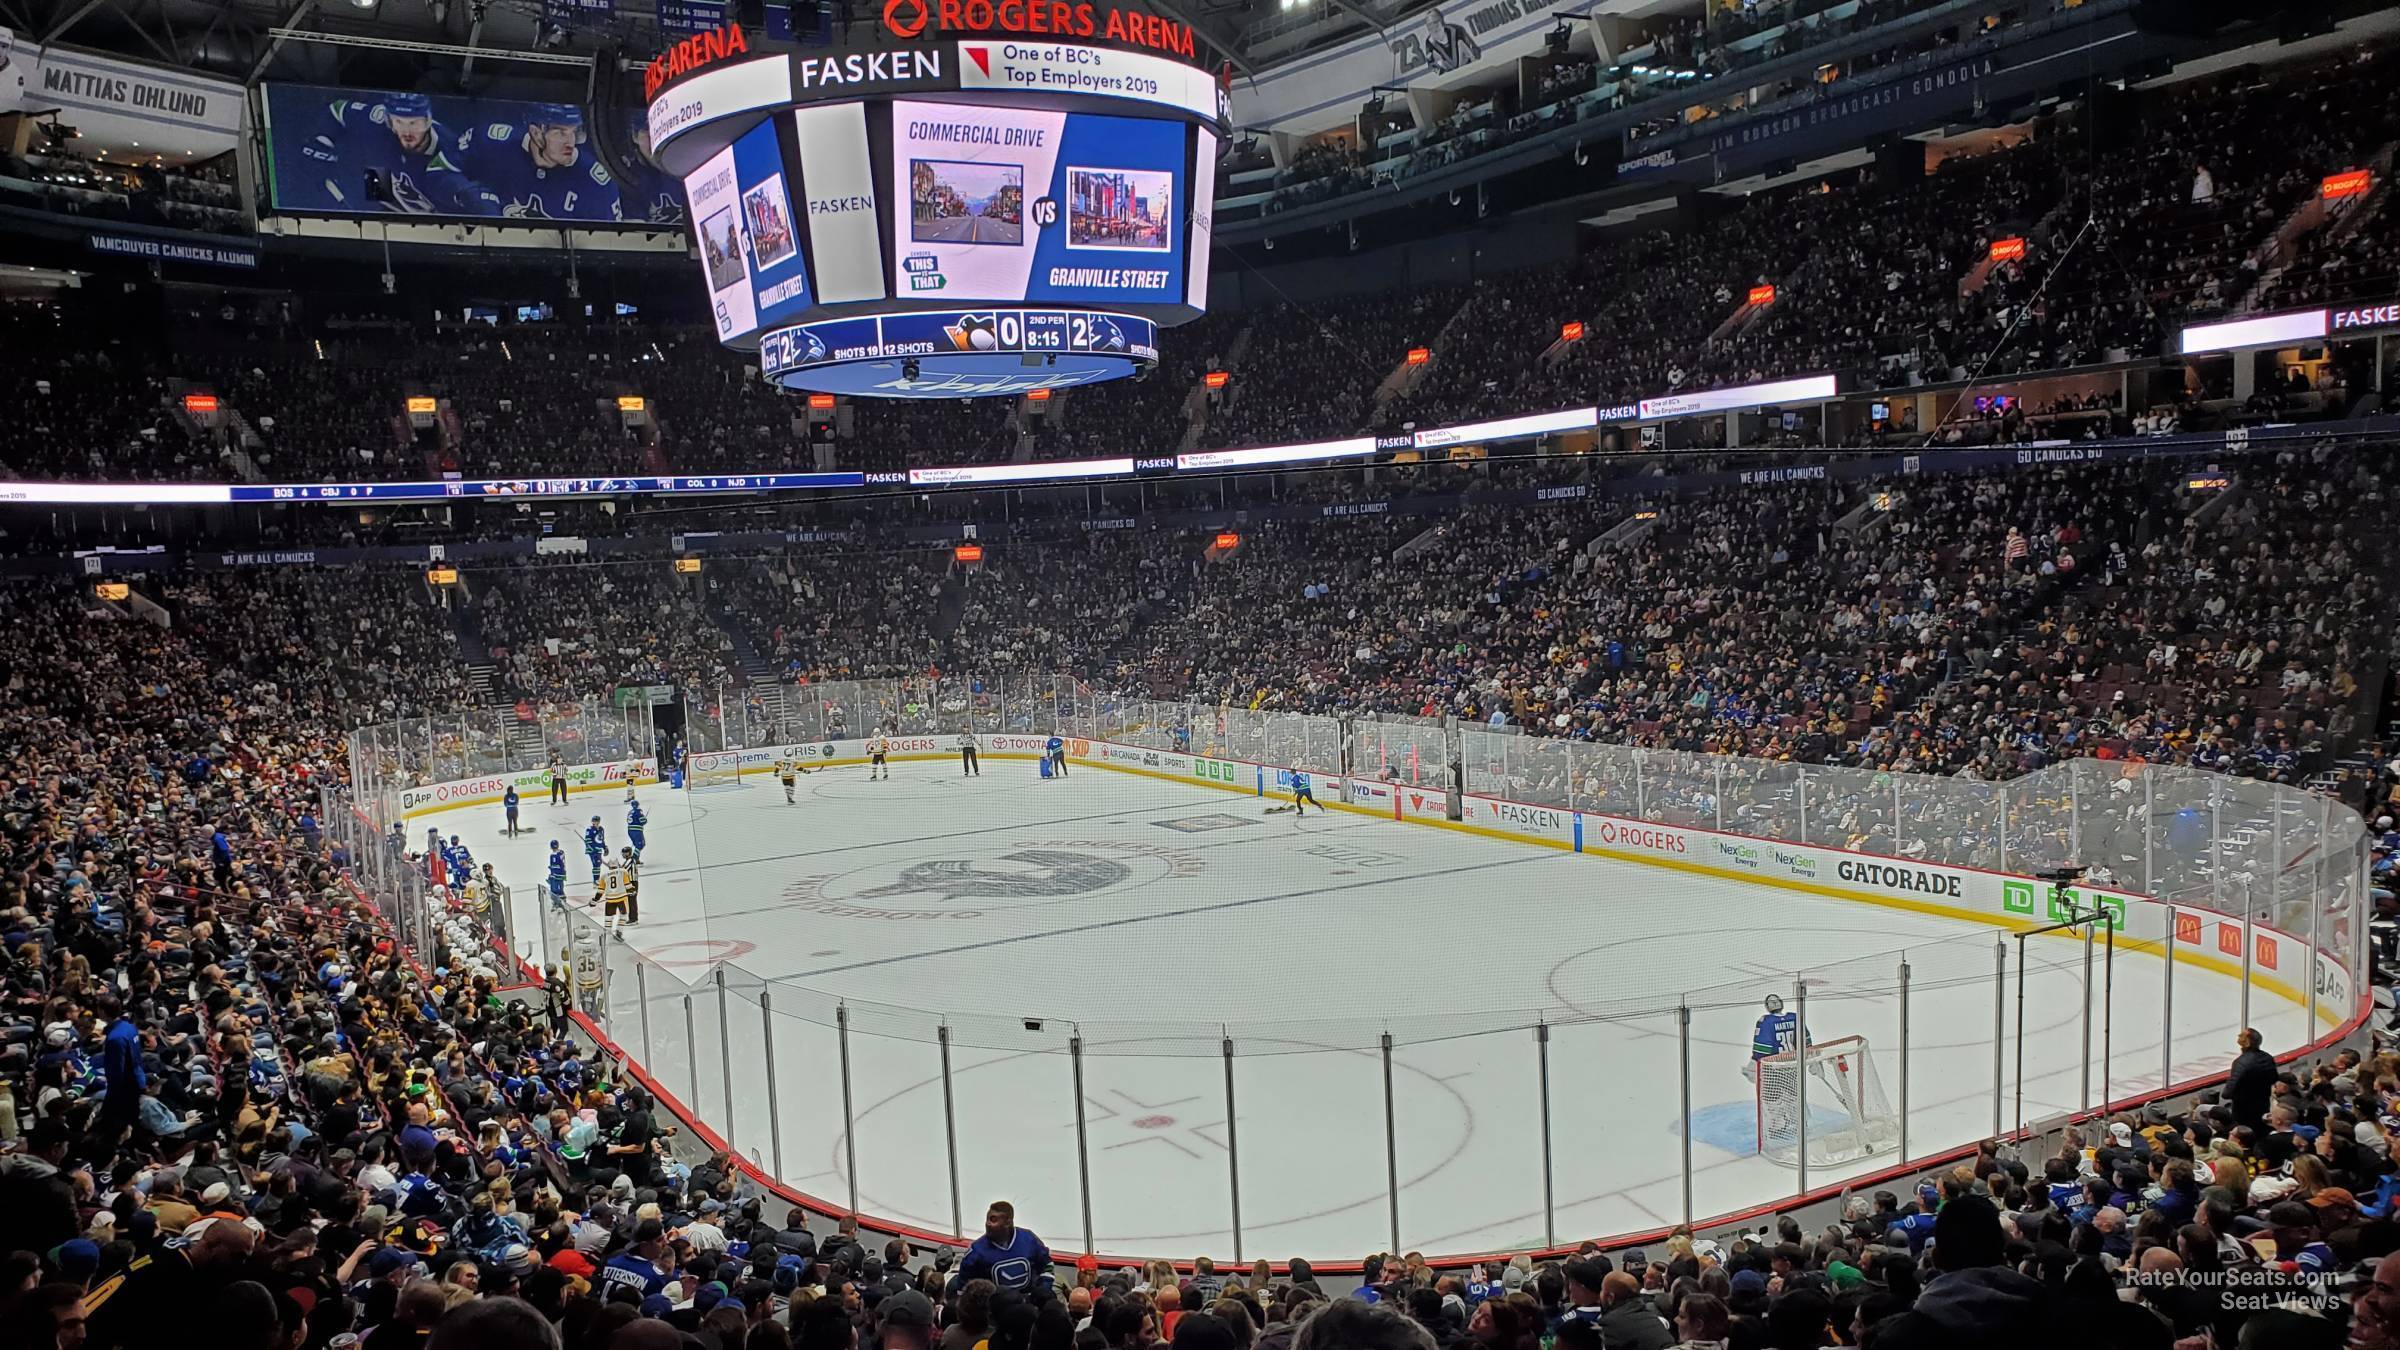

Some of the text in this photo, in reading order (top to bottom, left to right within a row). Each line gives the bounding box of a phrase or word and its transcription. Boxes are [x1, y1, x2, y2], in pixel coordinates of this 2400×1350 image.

[940, 0, 1196, 59] ROGERS ARENA
[669, 23, 748, 80] ARENA
[1003, 45, 1101, 66] One of BC's
[801, 50, 941, 89] FASKEN
[43, 67, 128, 102] MATTIAS
[1004, 66, 1158, 95] Top Employers 2019
[680, 100, 703, 123] 2019
[909, 121, 1045, 147] COMMERCIAL DRIVE
[810, 196, 872, 215] FASKEN
[1035, 201, 1056, 224] VS
[92, 235, 255, 266] VANCOUVER CANUCKS ALUMNI
[909, 258, 935, 271] THIS
[913, 276, 941, 289] THAT
[1050, 267, 1169, 290] GRANVILLE STREET
[1029, 315, 1065, 326] 2ND PER
[2335, 305, 2400, 329] FASKE
[1001, 317, 1019, 346] 0
[1028, 330, 1060, 347] 8:15
[1073, 317, 1088, 347] 2
[834, 347, 865, 360] SHOTS
[883, 341, 935, 356] 12 SHOTS
[1600, 406, 1636, 420] FASKEN
[1377, 436, 1412, 449] FASKEN
[1137, 458, 1174, 470] FASKEN
[687, 480, 705, 488] COL
[728, 478, 746, 487] NJD
[866, 472, 906, 484] FASKEN
[1740, 466, 1825, 484] WE ARE ALL CANUCKS
[273, 488, 294, 498] BOS
[301, 488, 308, 497] 4
[321, 487, 340, 497] CBJ
[350, 487, 358, 497] 0
[537, 481, 546, 492] 0
[580, 481, 589, 491] 2
[1547, 487, 1576, 499] CANUCKS
[1323, 502, 1388, 516] WE ARE ALL CANUCKS
[222, 552, 315, 565] WE ARE ALL CANUCKS
[1010, 739, 1048, 750] TOYOTA
[1072, 740, 1090, 757] SKIP
[721, 752, 770, 766] Supreme
[452, 779, 504, 798] ROGERS
[1501, 805, 1560, 830] FASKEN
[1620, 827, 1685, 853] ROGERS
[1720, 843, 1758, 859] NexGen
[1735, 857, 1758, 868] Energy
[1775, 851, 1816, 869] NexGen
[1791, 867, 1815, 878] Energy
[1838, 860, 1961, 898] GATORADE
[610, 876, 617, 889] 8
[2006, 886, 2031, 908] TD
[577, 956, 596, 973] 35
[1774, 1020, 1795, 1031] MARTIN
